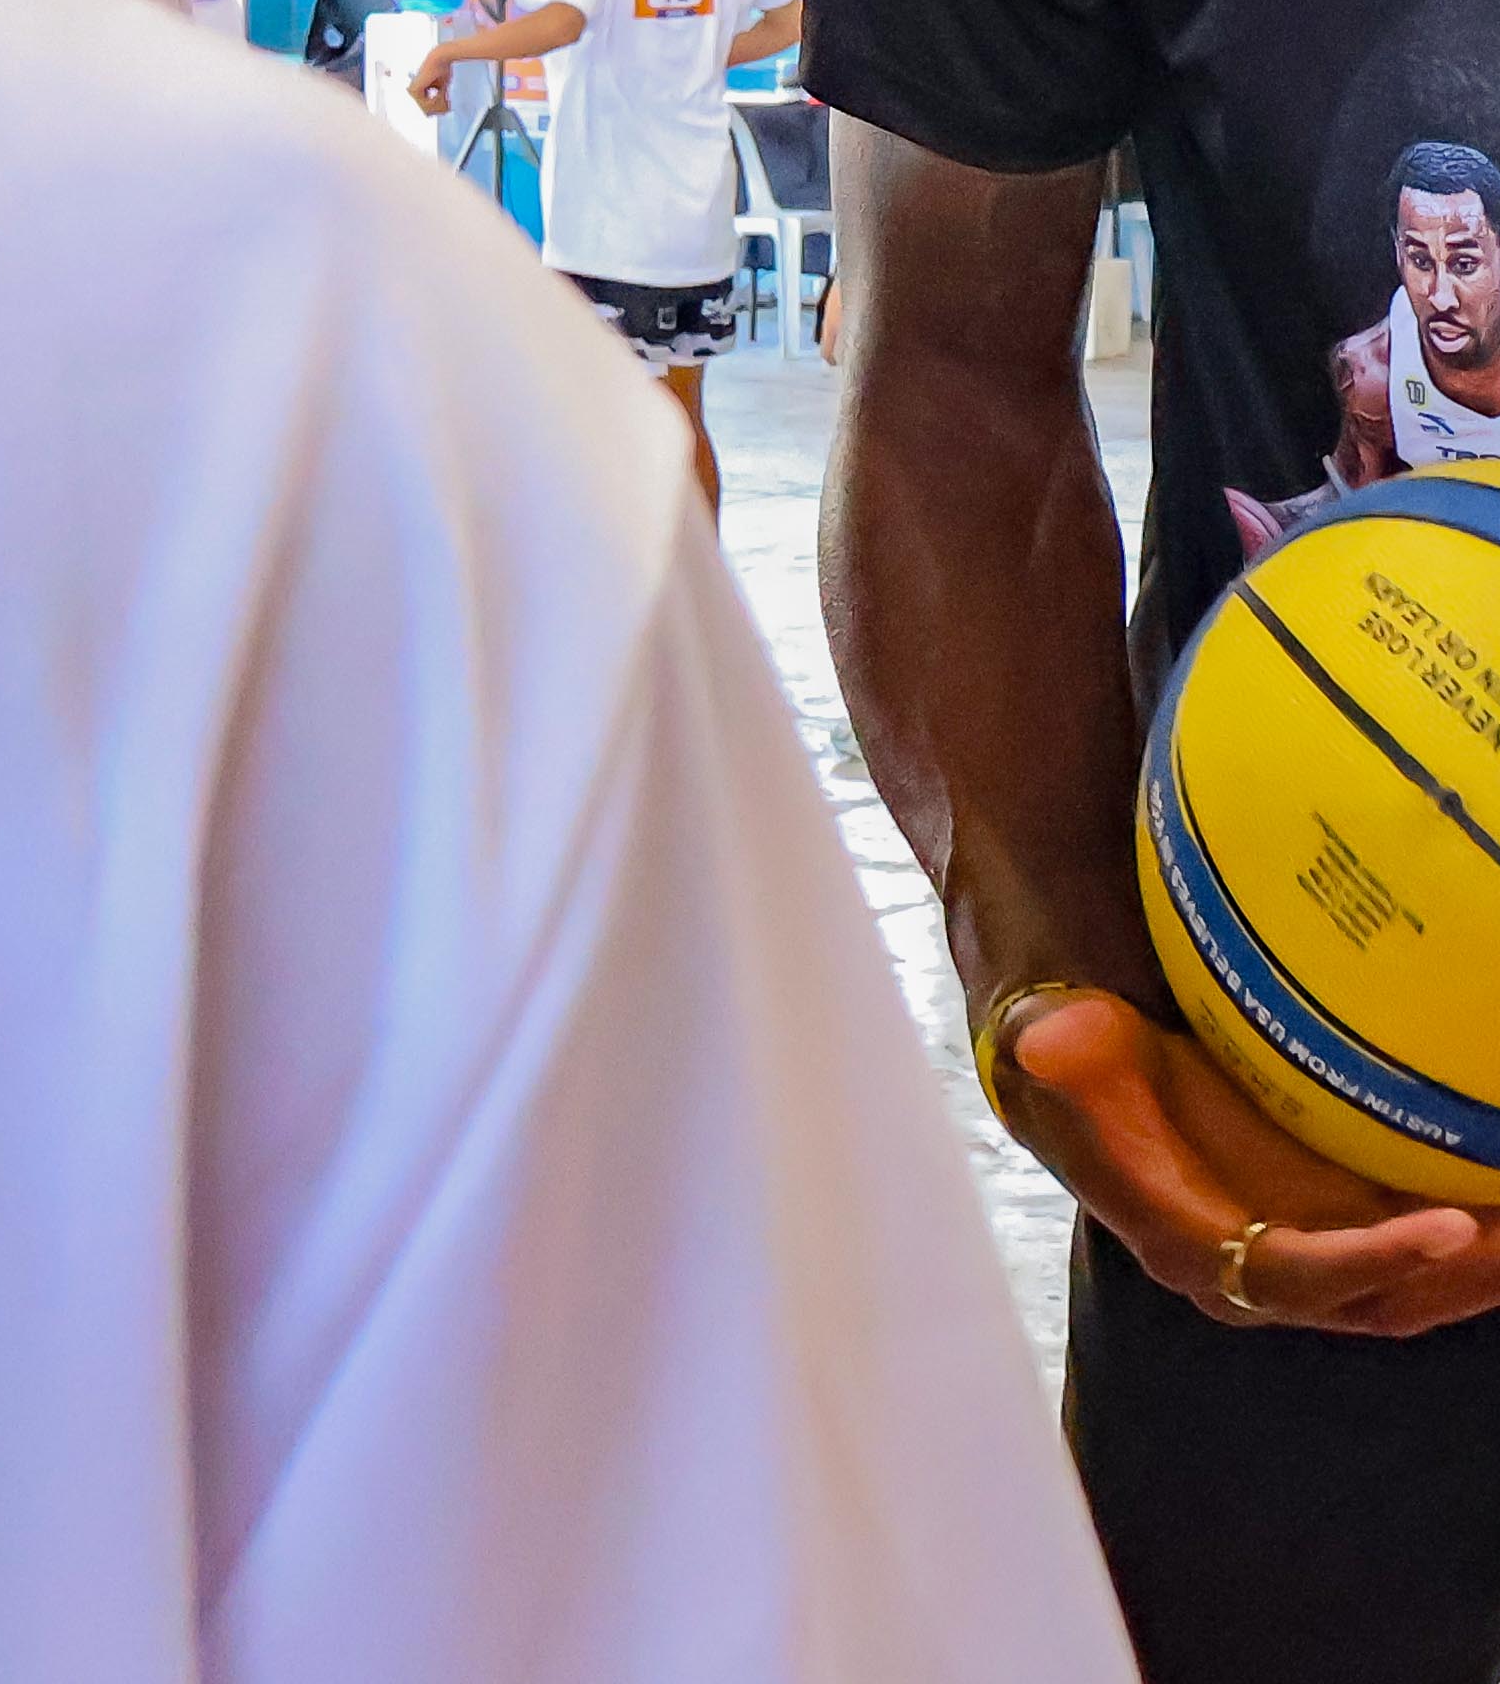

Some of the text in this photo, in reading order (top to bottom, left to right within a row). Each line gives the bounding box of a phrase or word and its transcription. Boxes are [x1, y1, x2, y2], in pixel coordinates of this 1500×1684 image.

[1357, 608, 1425, 670] LOSE
[1436, 628, 1478, 672] OR
[1244, 986, 1287, 1042] USA
[1287, 1038, 1358, 1097] FROM
[1366, 1092, 1462, 1146] AUSTIN
